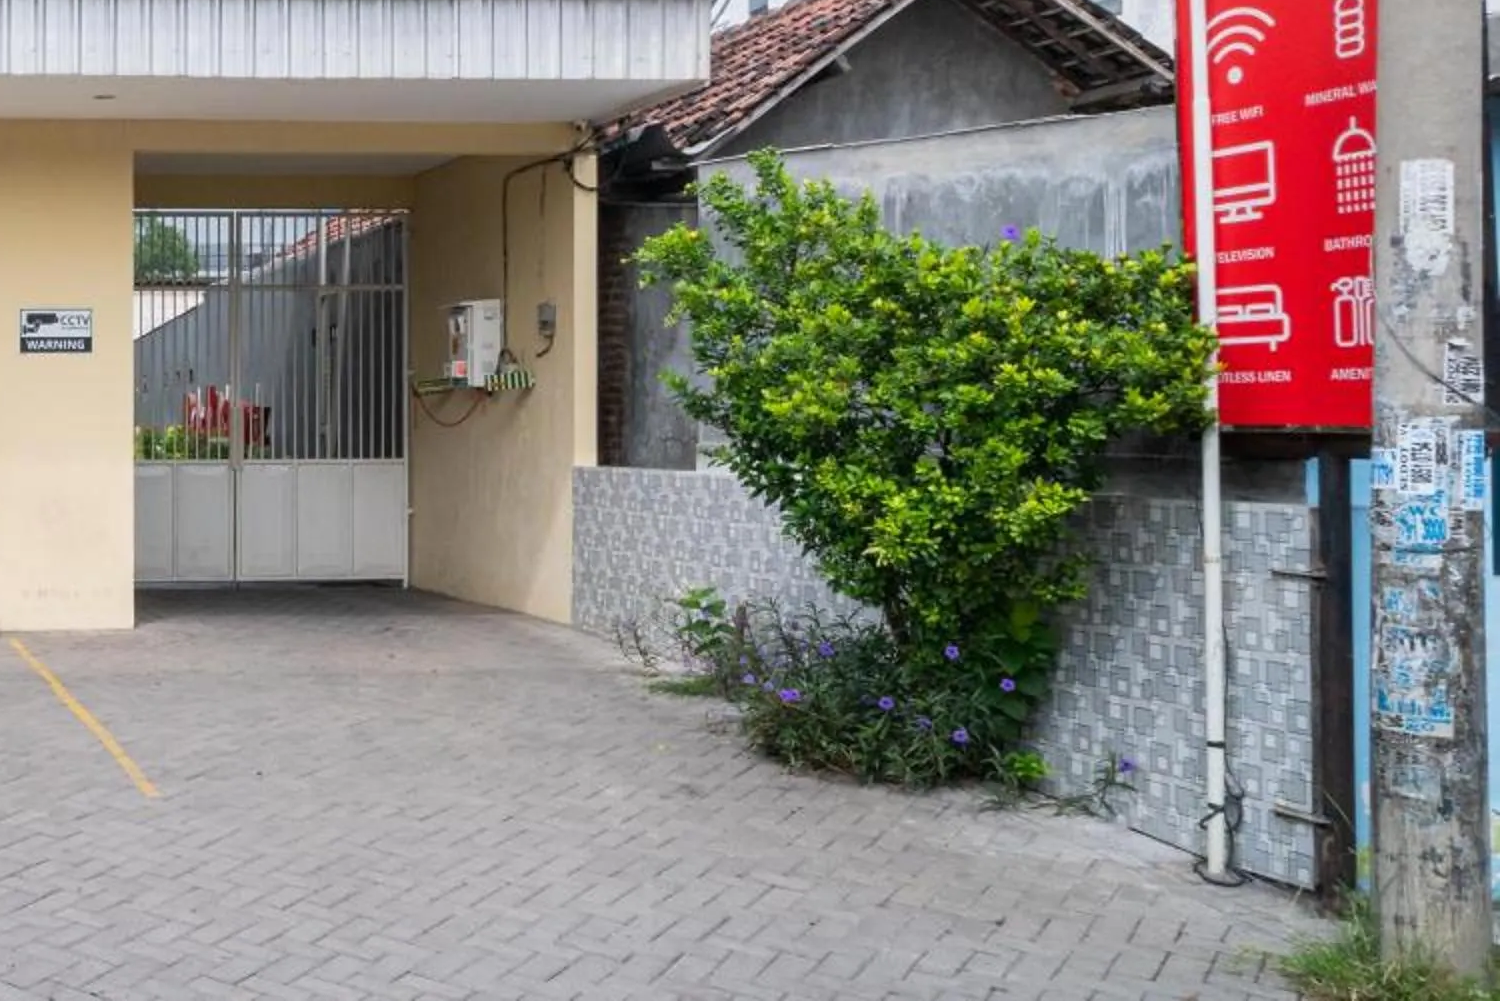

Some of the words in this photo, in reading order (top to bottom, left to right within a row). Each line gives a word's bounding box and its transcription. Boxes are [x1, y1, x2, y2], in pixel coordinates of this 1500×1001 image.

[1304, 84, 1357, 107] MINERAL
[1323, 234, 1373, 252] BATHRO
[1216, 246, 1276, 264] ELEVISION
[60, 313, 90, 326] CCTV
[26, 338, 85, 350] WARNING
[1257, 369, 1293, 384] LINEN
